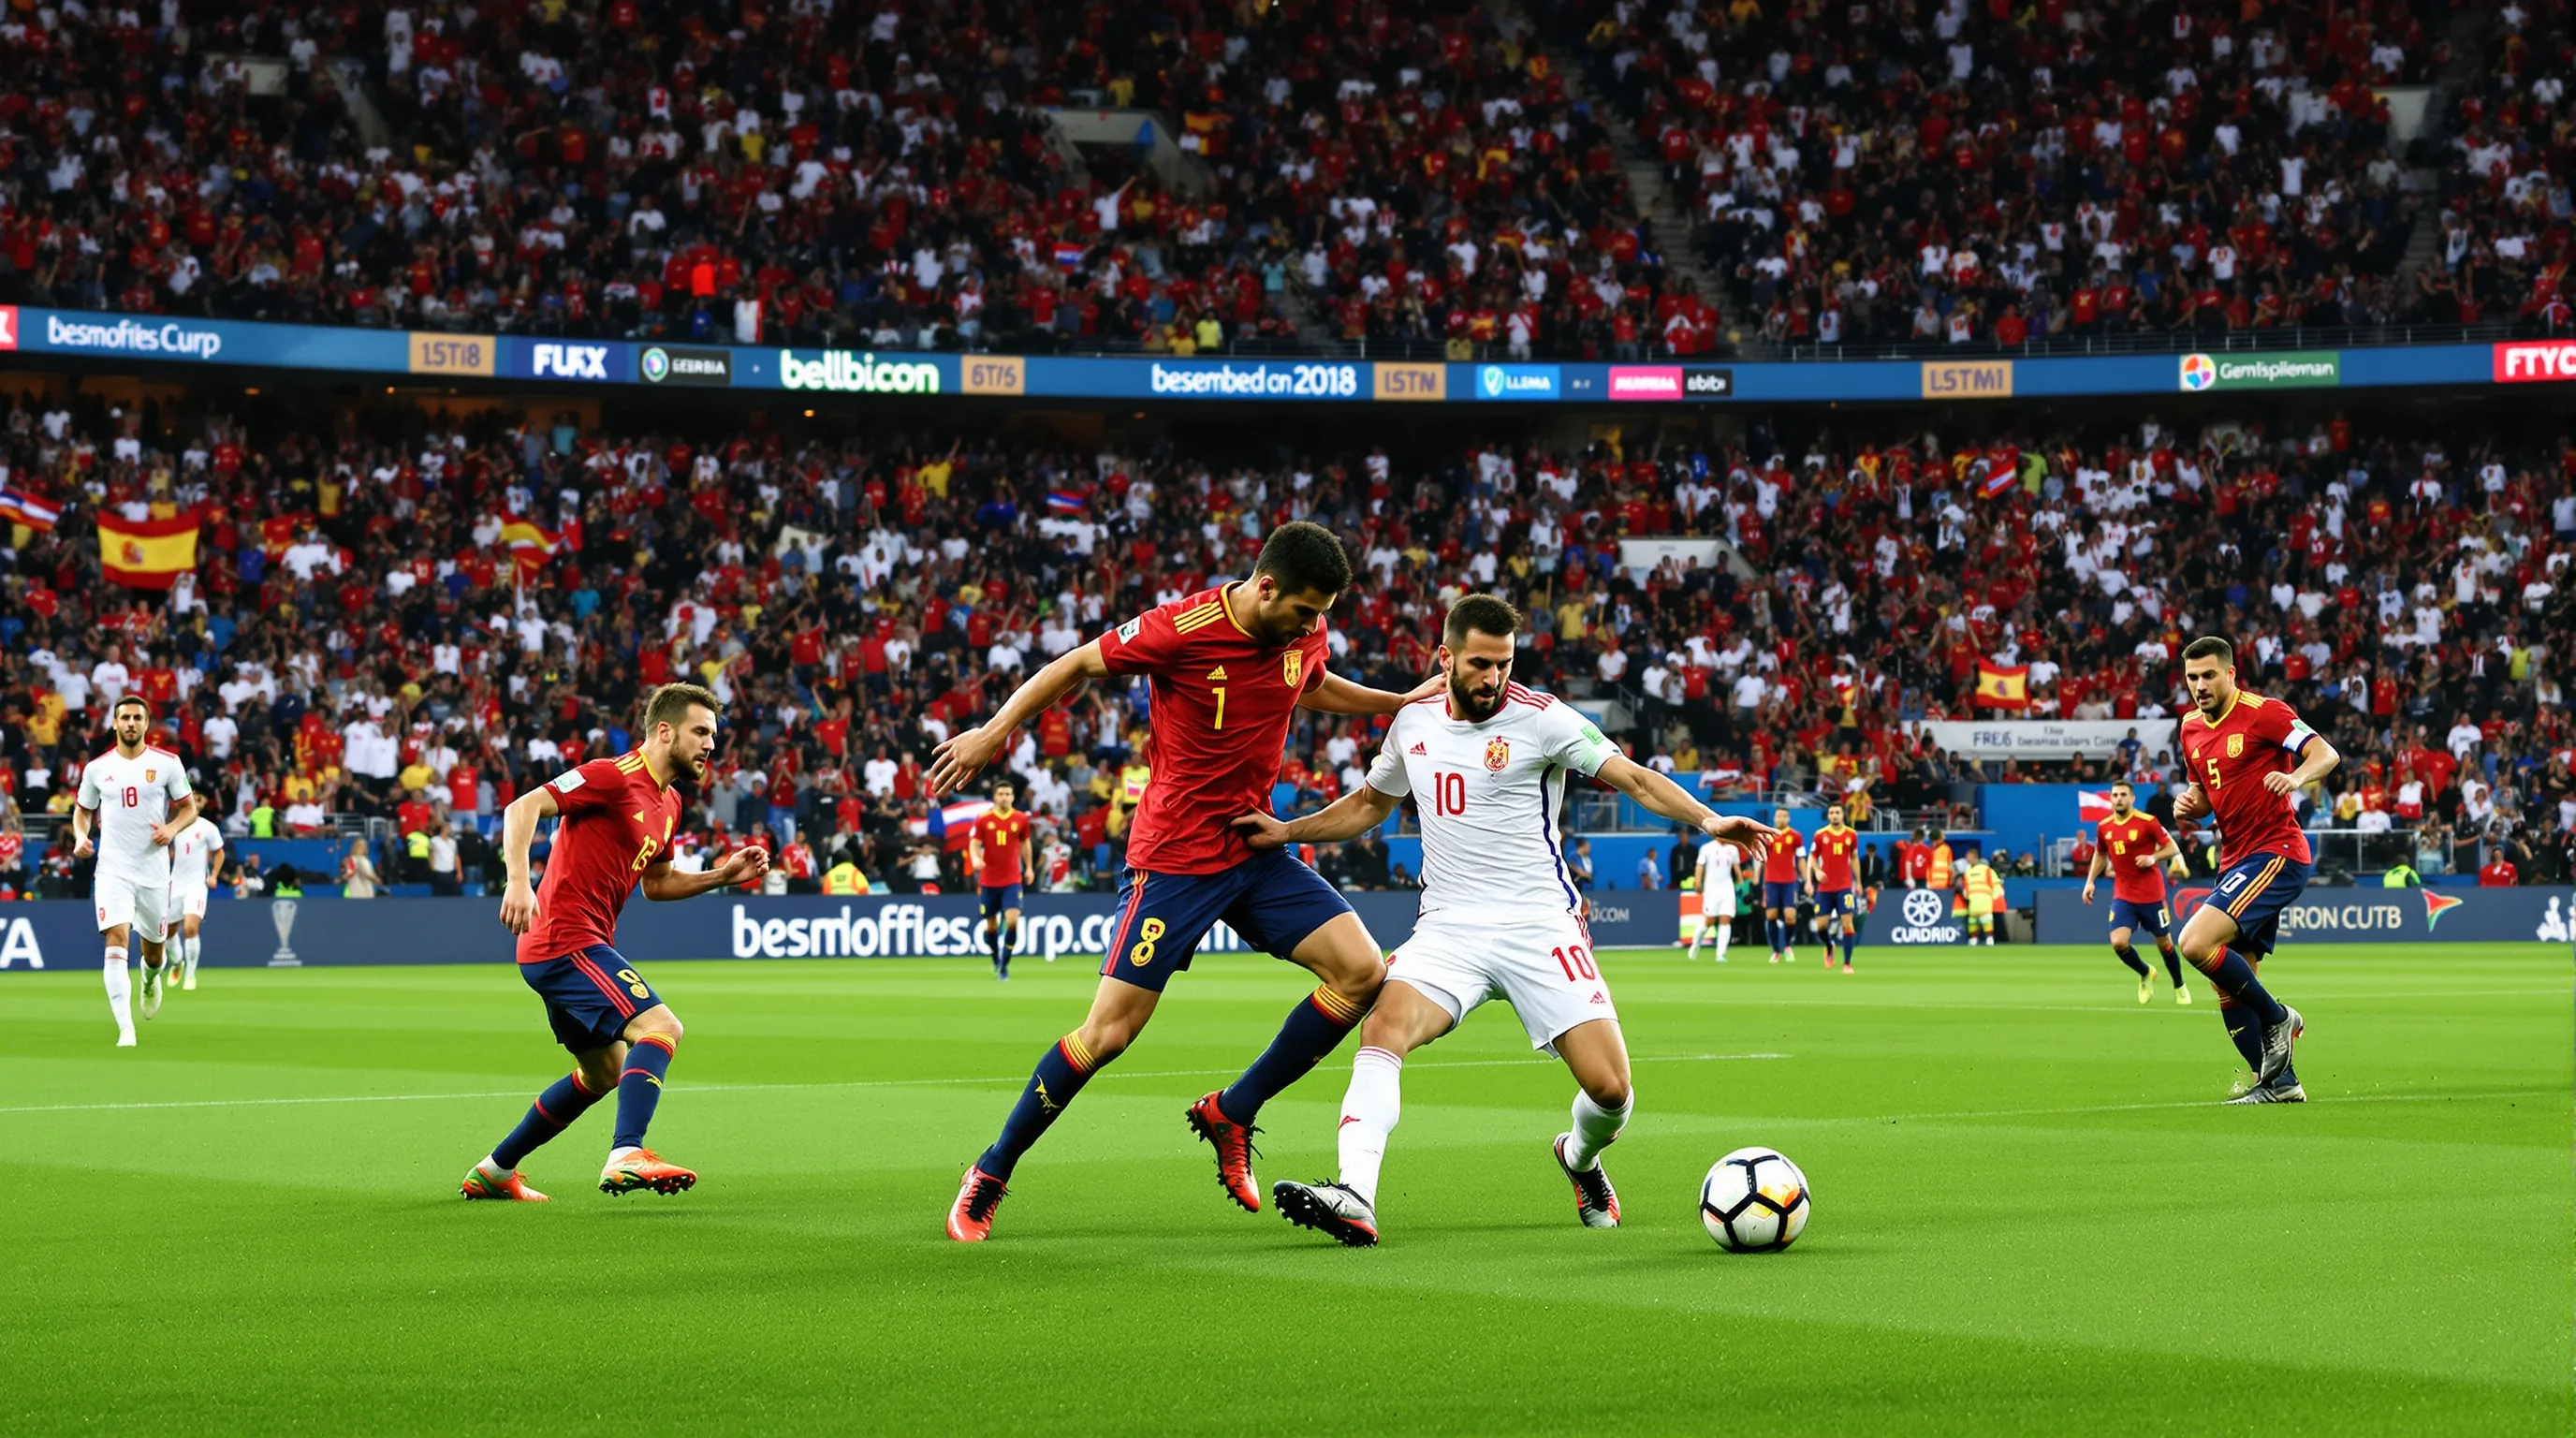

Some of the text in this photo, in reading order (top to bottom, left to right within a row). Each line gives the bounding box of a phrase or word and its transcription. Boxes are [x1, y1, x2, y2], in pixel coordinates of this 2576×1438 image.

[160, 323, 221, 359] Curp
[780, 349, 940, 393] bellbicon
[1294, 364, 1357, 396] 2018
[1212, 687, 1225, 730] 7
[1434, 771, 1466, 817] 10
[2341, 905, 2402, 930] CUTB
[0, 917, 45, 969] A
[1551, 944, 1596, 983] 10
